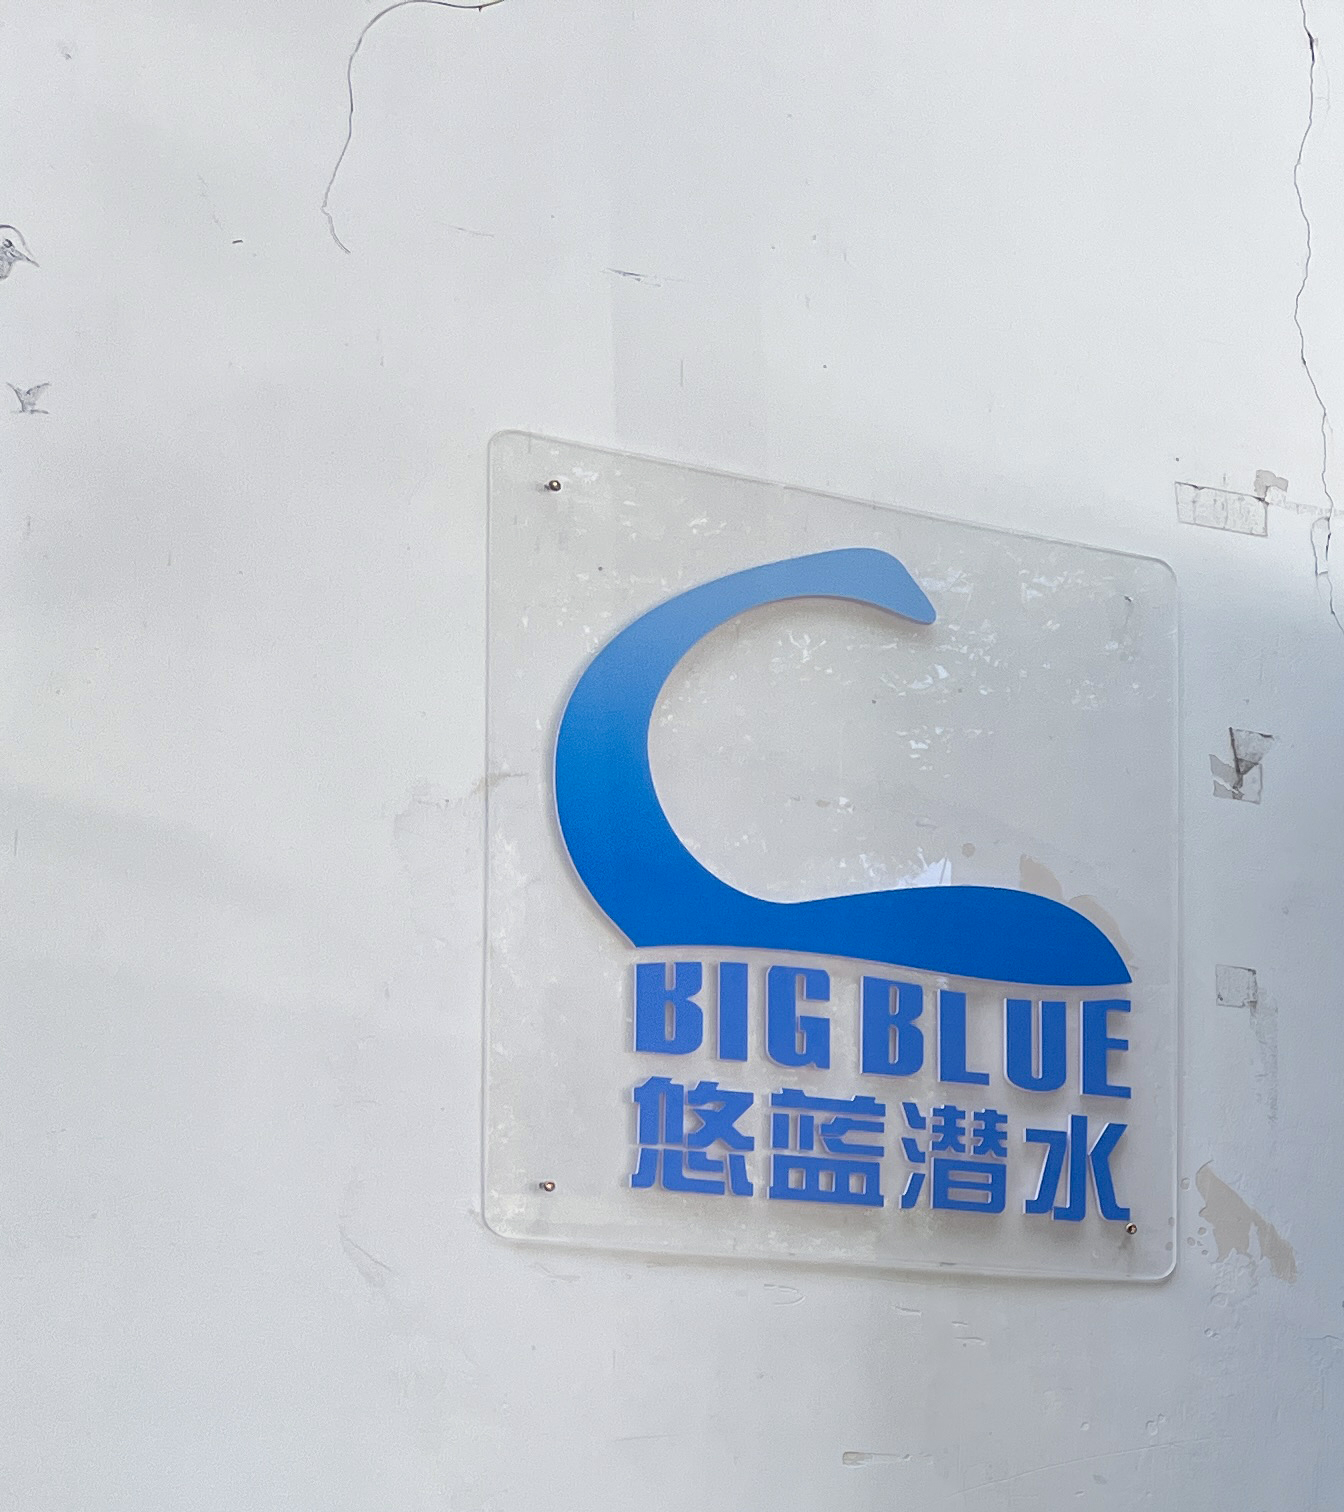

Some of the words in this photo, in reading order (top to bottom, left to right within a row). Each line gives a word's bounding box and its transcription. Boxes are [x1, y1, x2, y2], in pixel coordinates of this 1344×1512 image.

[633, 960, 831, 1070] BIG
[860, 975, 1133, 1100] BLUE
[630, 1075, 1132, 1222] 悠蓝潜水
